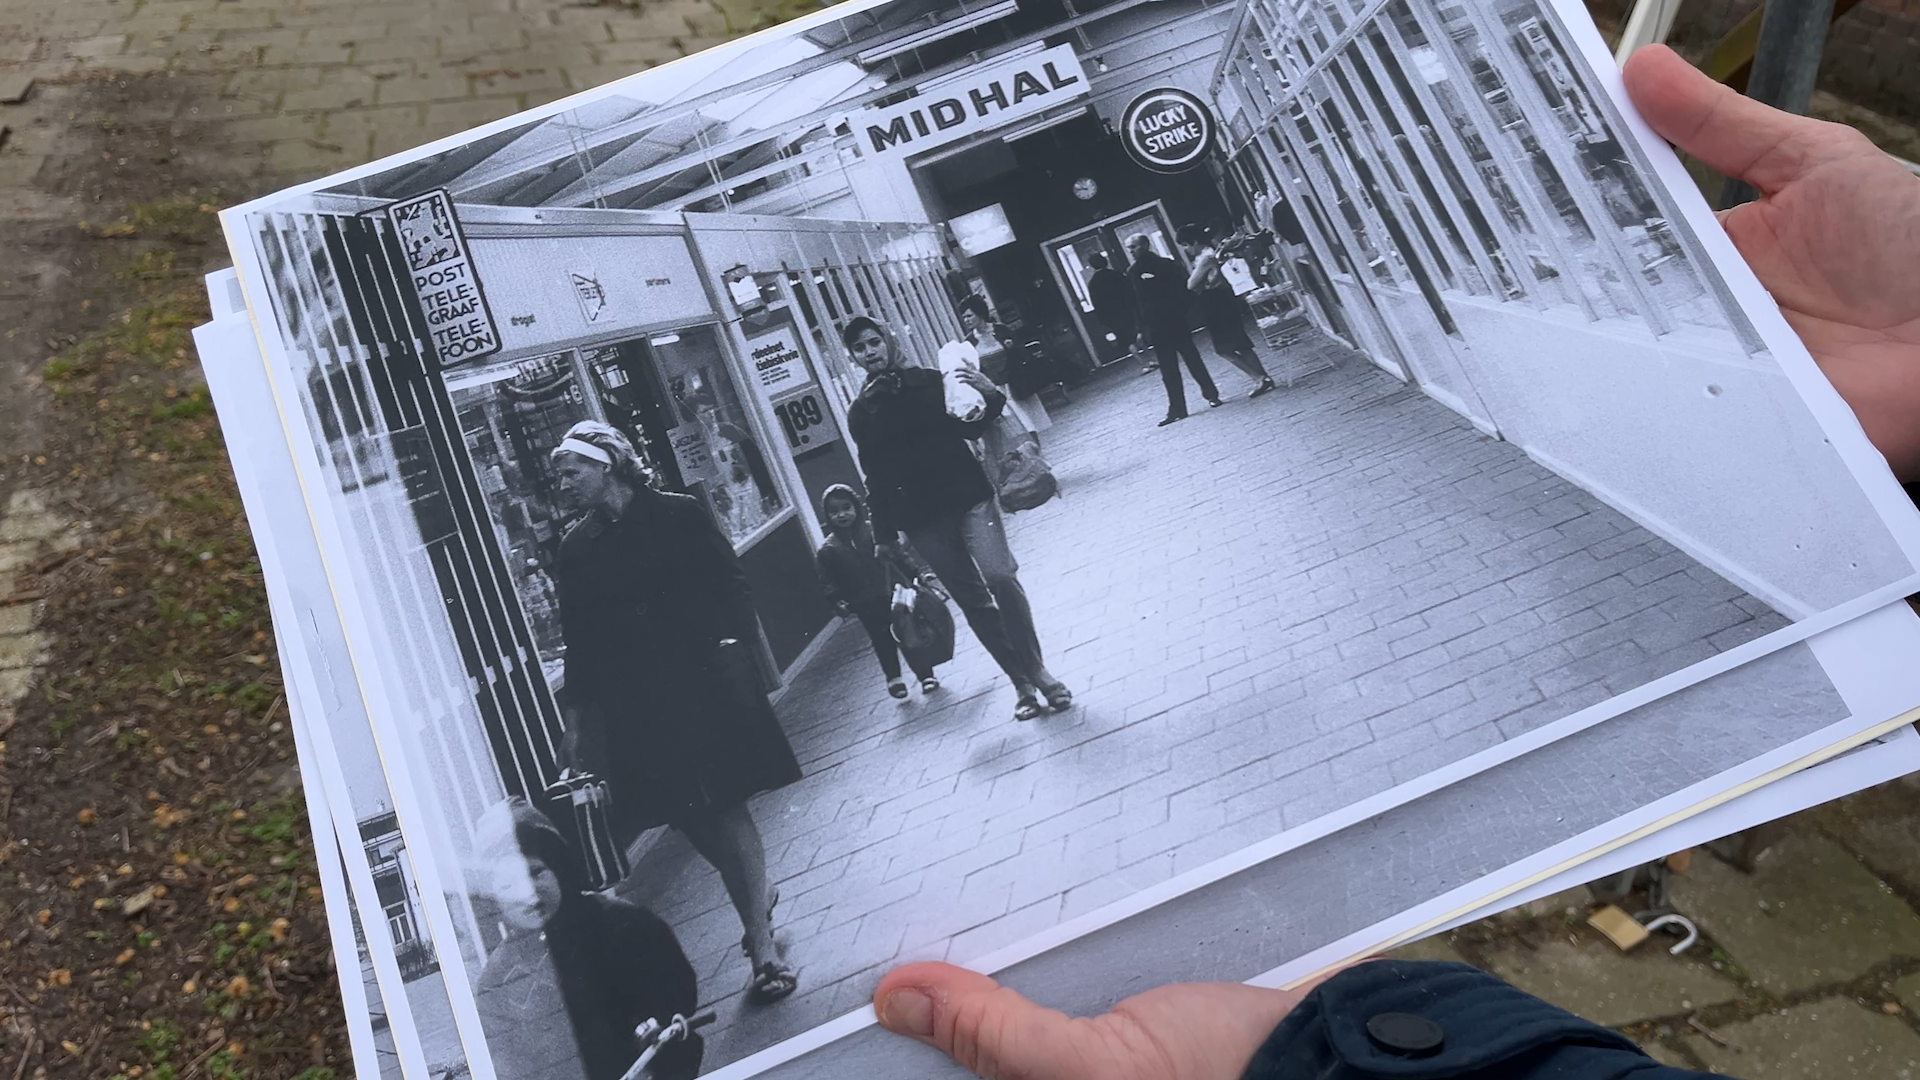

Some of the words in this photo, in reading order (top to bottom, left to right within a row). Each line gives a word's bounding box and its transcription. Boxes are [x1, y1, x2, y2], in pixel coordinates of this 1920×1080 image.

[866, 60, 1079, 153] MIDHAL
[1139, 106, 1188, 135] LUCKY
[1144, 122, 1201, 155] STRIKE
[415, 262, 466, 292] POST
[422, 284, 474, 311] TELE-
[428, 297, 479, 326] GRAAF
[434, 320, 486, 345] TELE-
[439, 332, 493, 362] FOON
